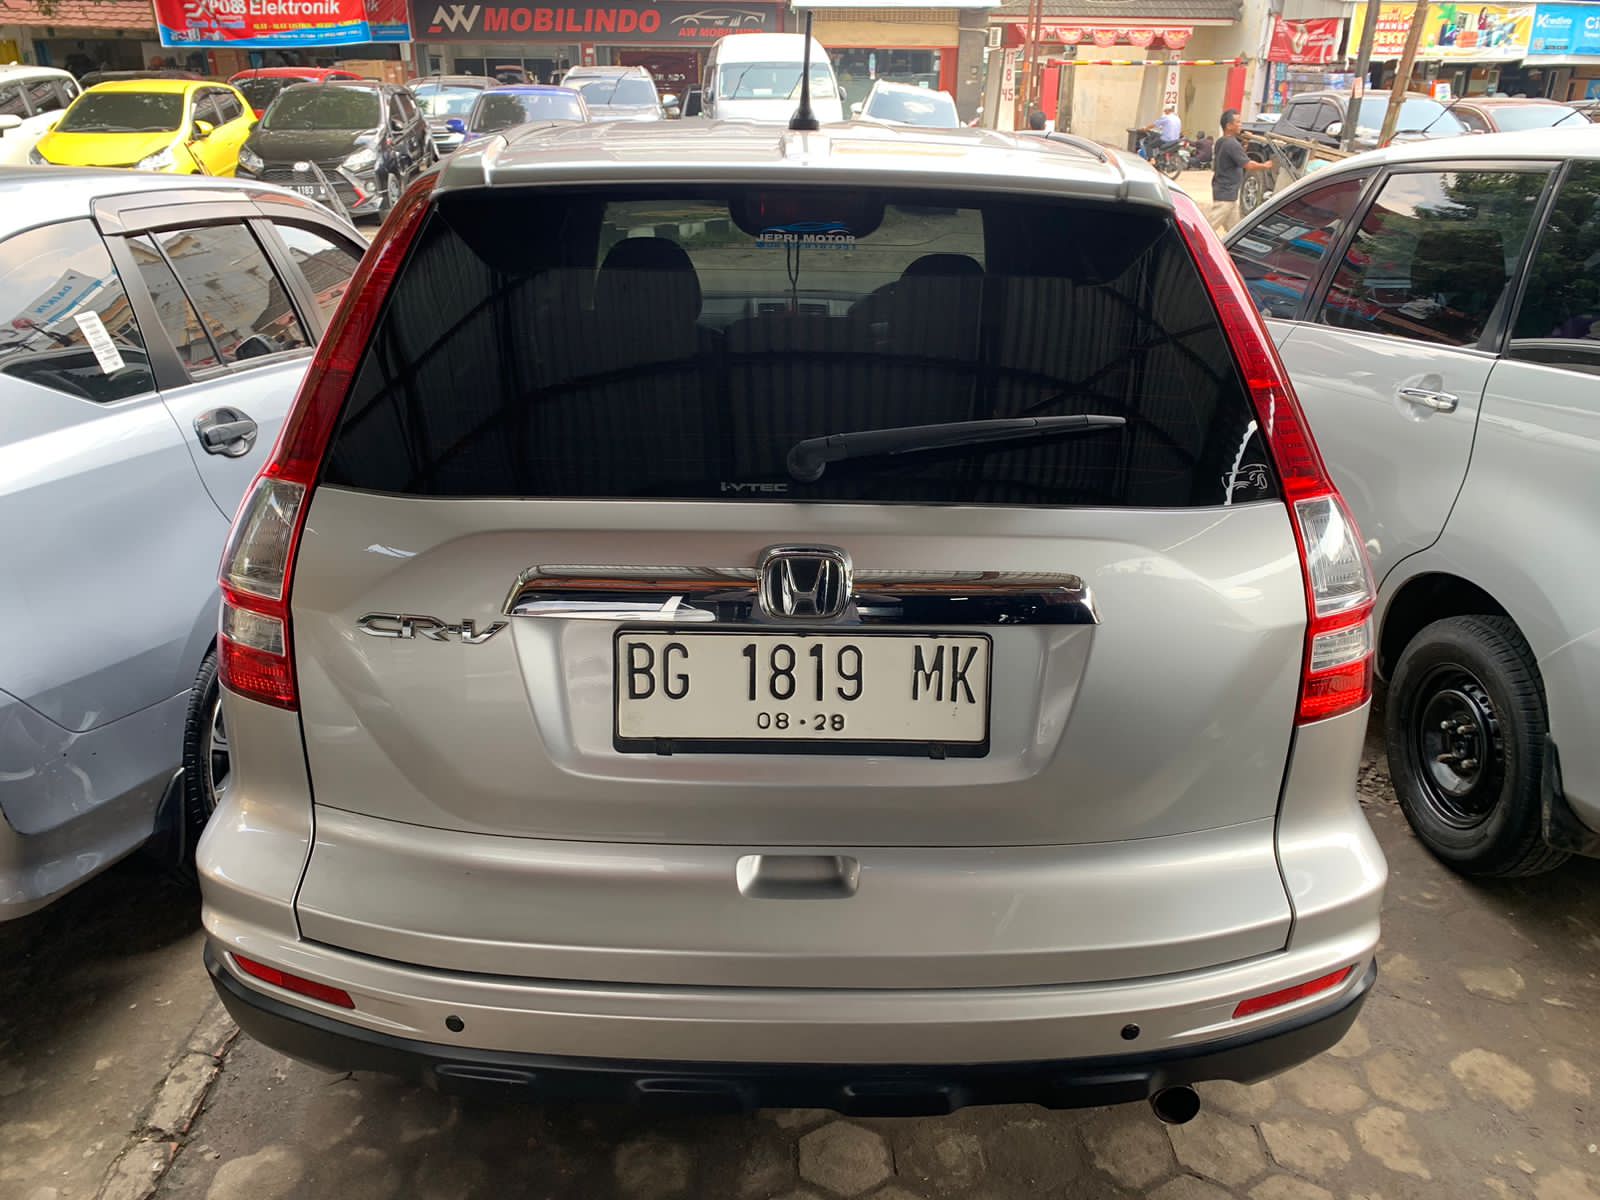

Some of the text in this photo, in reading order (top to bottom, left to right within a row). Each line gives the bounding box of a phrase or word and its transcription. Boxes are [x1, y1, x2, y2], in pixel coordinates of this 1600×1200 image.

[250, 0, 340, 15] Elektronik
[484, 8, 661, 33] MOBILINDO
[678, 27, 697, 38] AW
[1006, 68, 1012, 81] 8
[1170, 72, 1177, 85] 8
[1001, 88, 1014, 101] 45
[1165, 91, 1178, 105] 23
[757, 233, 856, 244] JEPRI MOTOR
[356, 612, 509, 645] CR-V
[627, 641, 978, 704] BG 1819 MK
